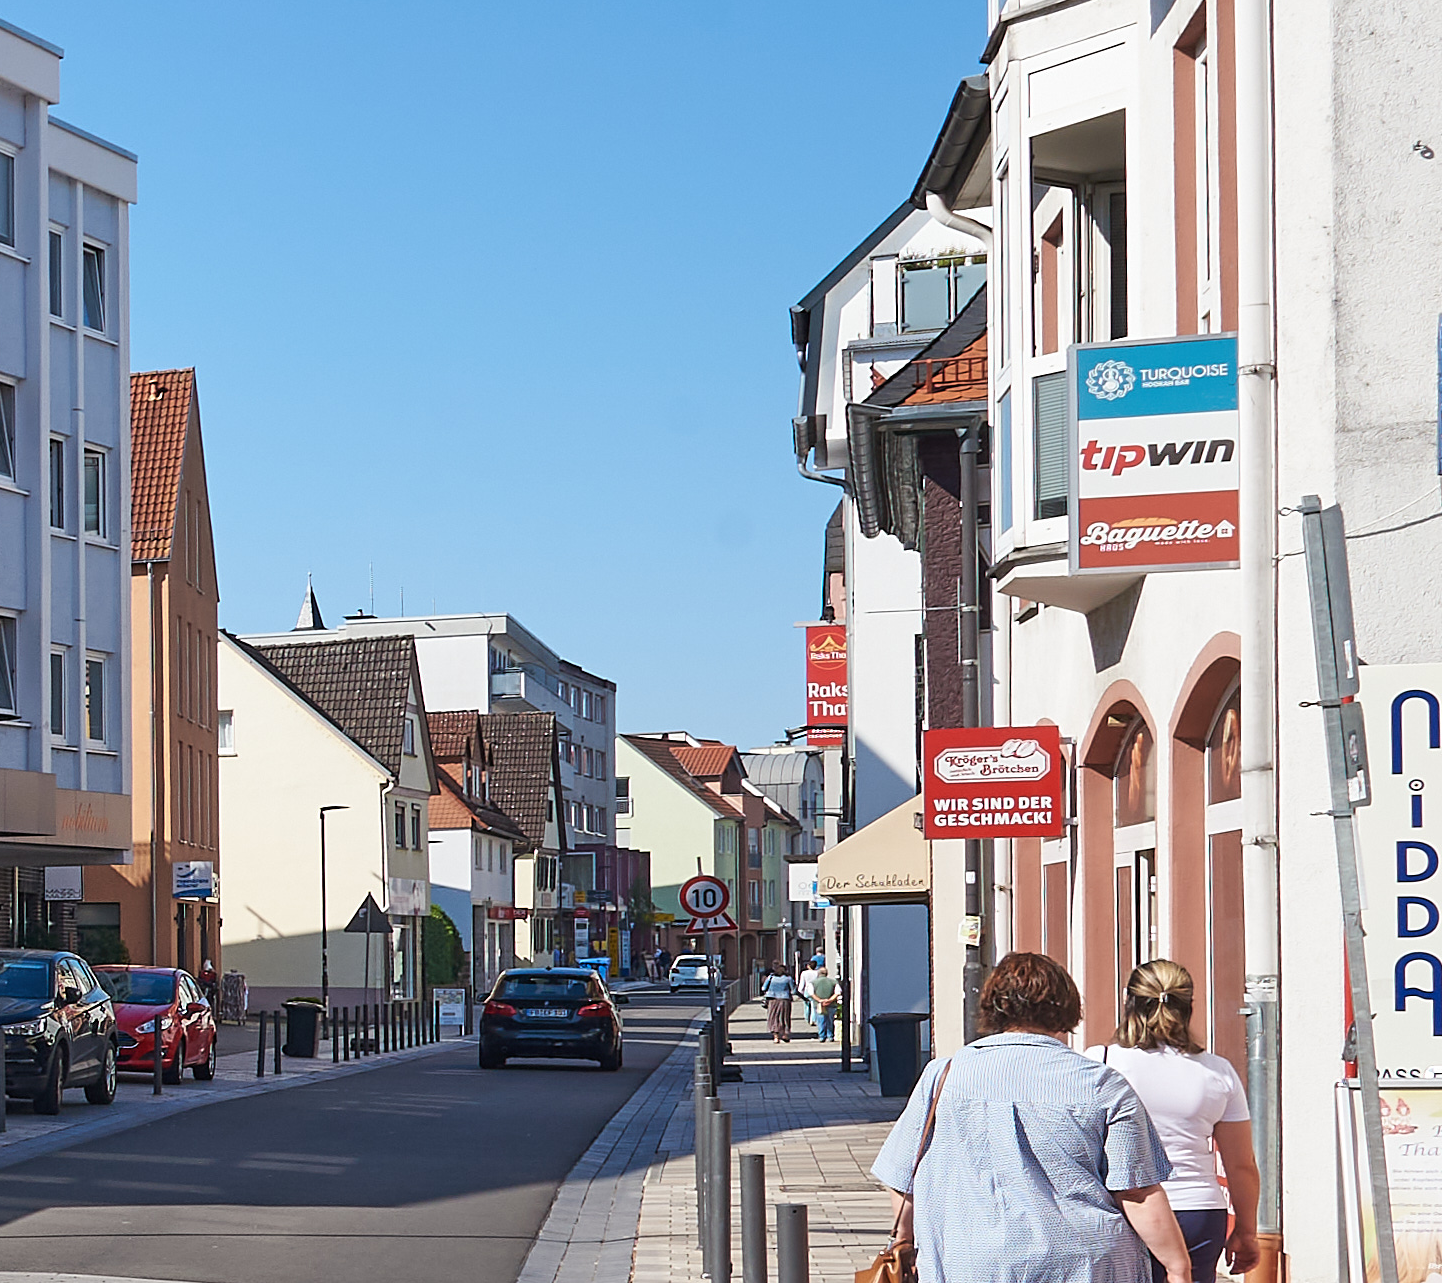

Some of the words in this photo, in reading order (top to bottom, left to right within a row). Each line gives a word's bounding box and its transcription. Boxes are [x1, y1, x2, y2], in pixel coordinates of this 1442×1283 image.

[1139, 363, 1229, 382] TURQUOISE
[1080, 439, 1235, 477] tipwin
[1080, 519, 1216, 550] Baguette
[831, 651, 847, 659] Tha
[808, 682, 848, 698] Raks
[809, 700, 848, 717] Tha
[945, 755, 998, 767] Kröger's
[980, 764, 1039, 776] Brötchen
[934, 798, 969, 812] WIR
[971, 797, 1015, 811] SIND
[1018, 796, 1053, 809] DER
[934, 811, 1052, 827] GESCHMACK!
[822, 876, 850, 890] Der
[691, 888, 717, 908] 10
